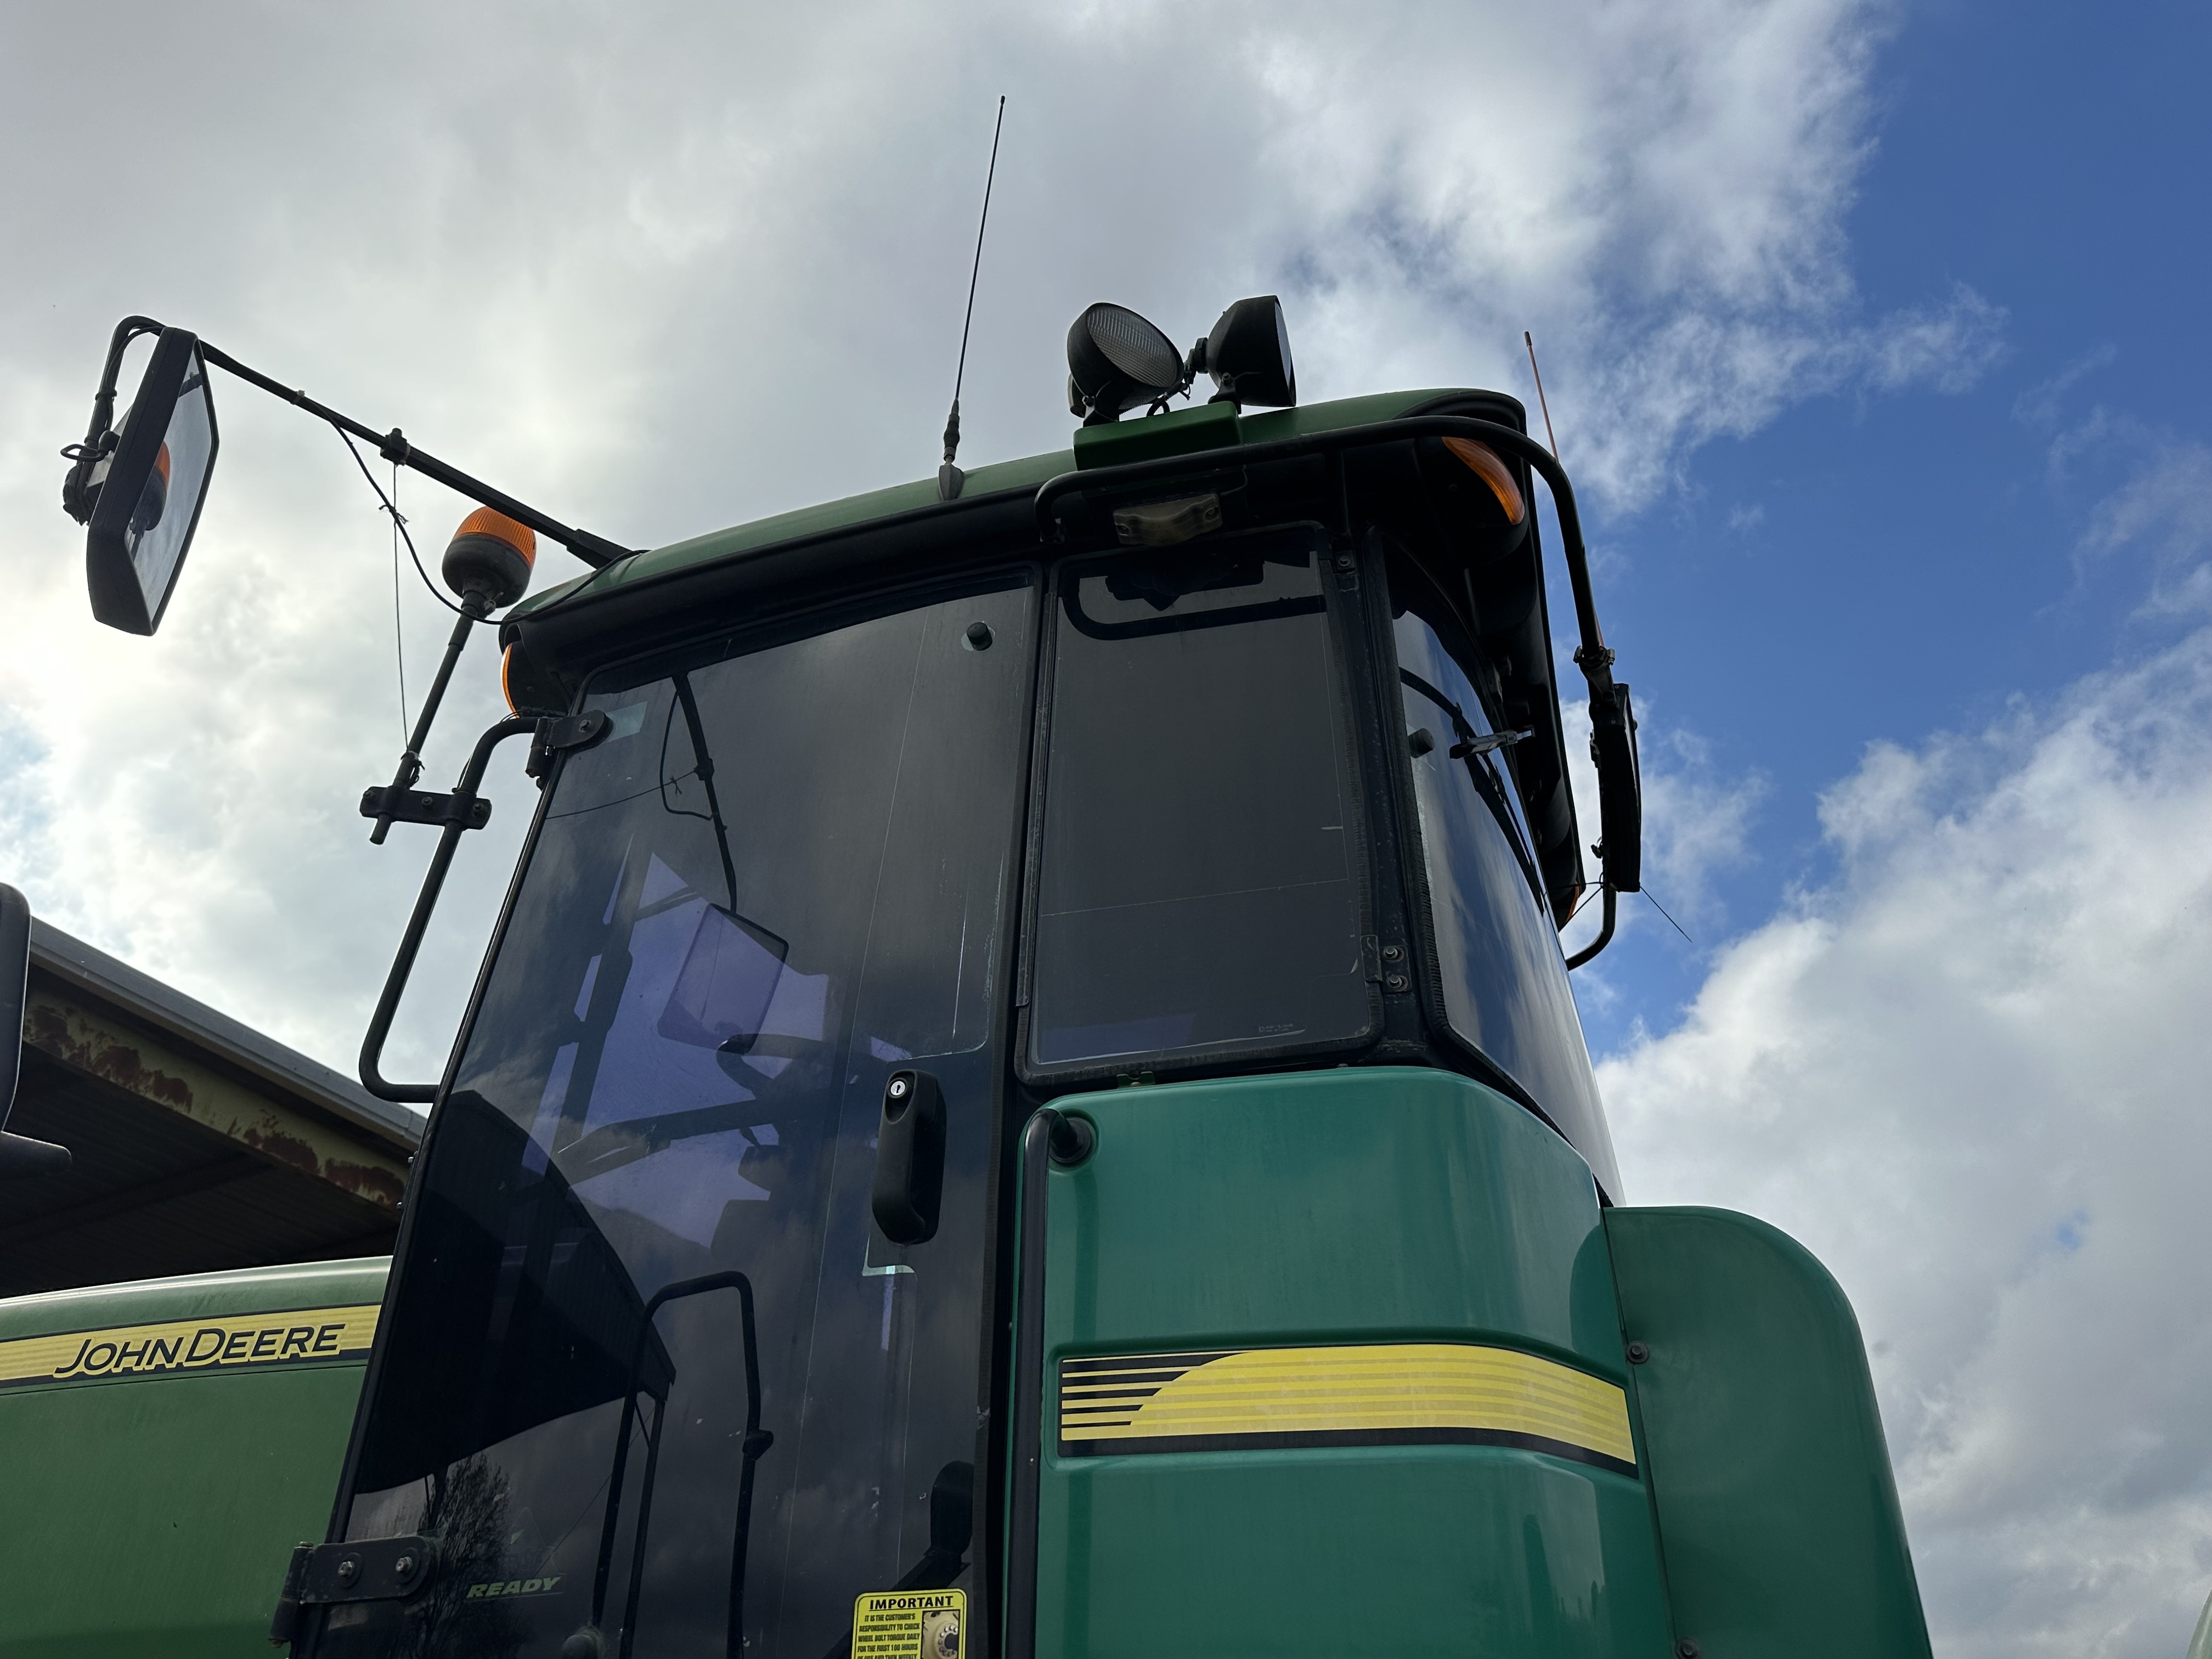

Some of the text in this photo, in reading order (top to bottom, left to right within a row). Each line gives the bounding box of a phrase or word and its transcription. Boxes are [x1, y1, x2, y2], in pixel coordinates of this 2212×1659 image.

[54, 1323, 346, 1373] JOHN DEERE
[466, 1576, 562, 1598] READY
[870, 1596, 953, 1610] IMPORTANT
[859, 1624, 896, 1632] RESPONSIBILITY
